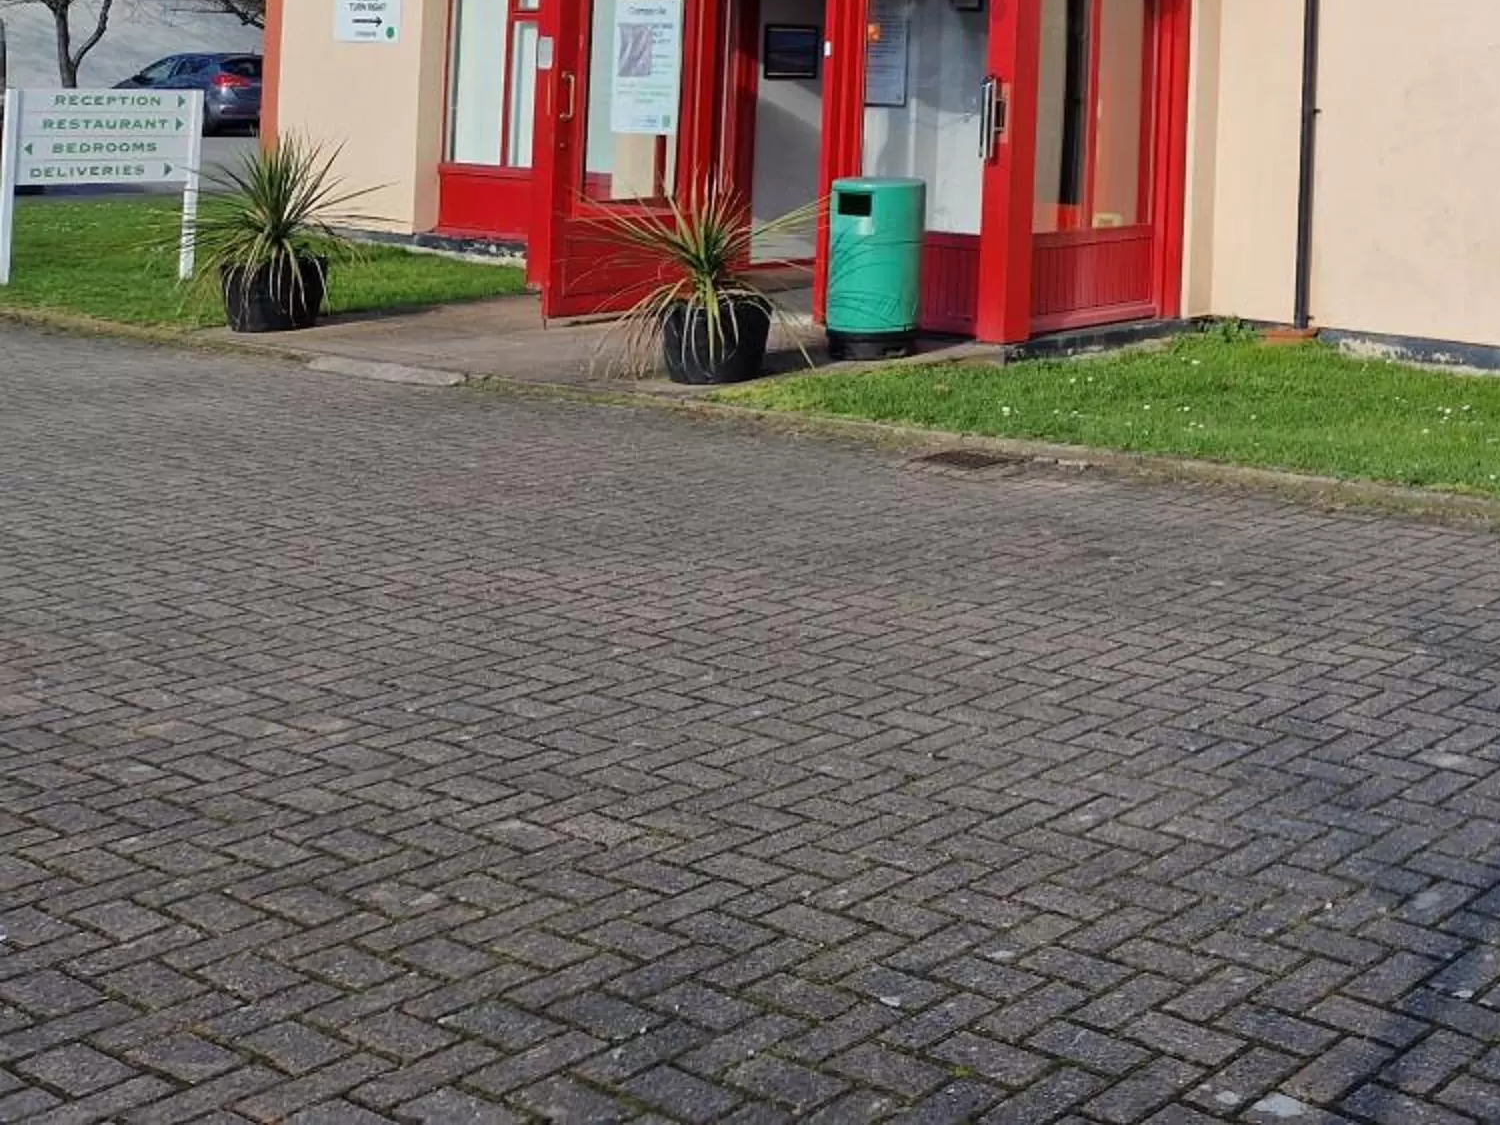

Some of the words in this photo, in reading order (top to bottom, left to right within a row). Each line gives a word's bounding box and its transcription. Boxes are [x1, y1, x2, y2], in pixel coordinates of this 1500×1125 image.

[53, 94, 161, 106] RECEPTION
[42, 118, 168, 130] RESTAURANT
[52, 142, 157, 154] BEDROOMS
[29, 164, 145, 179] DELIVERIES
